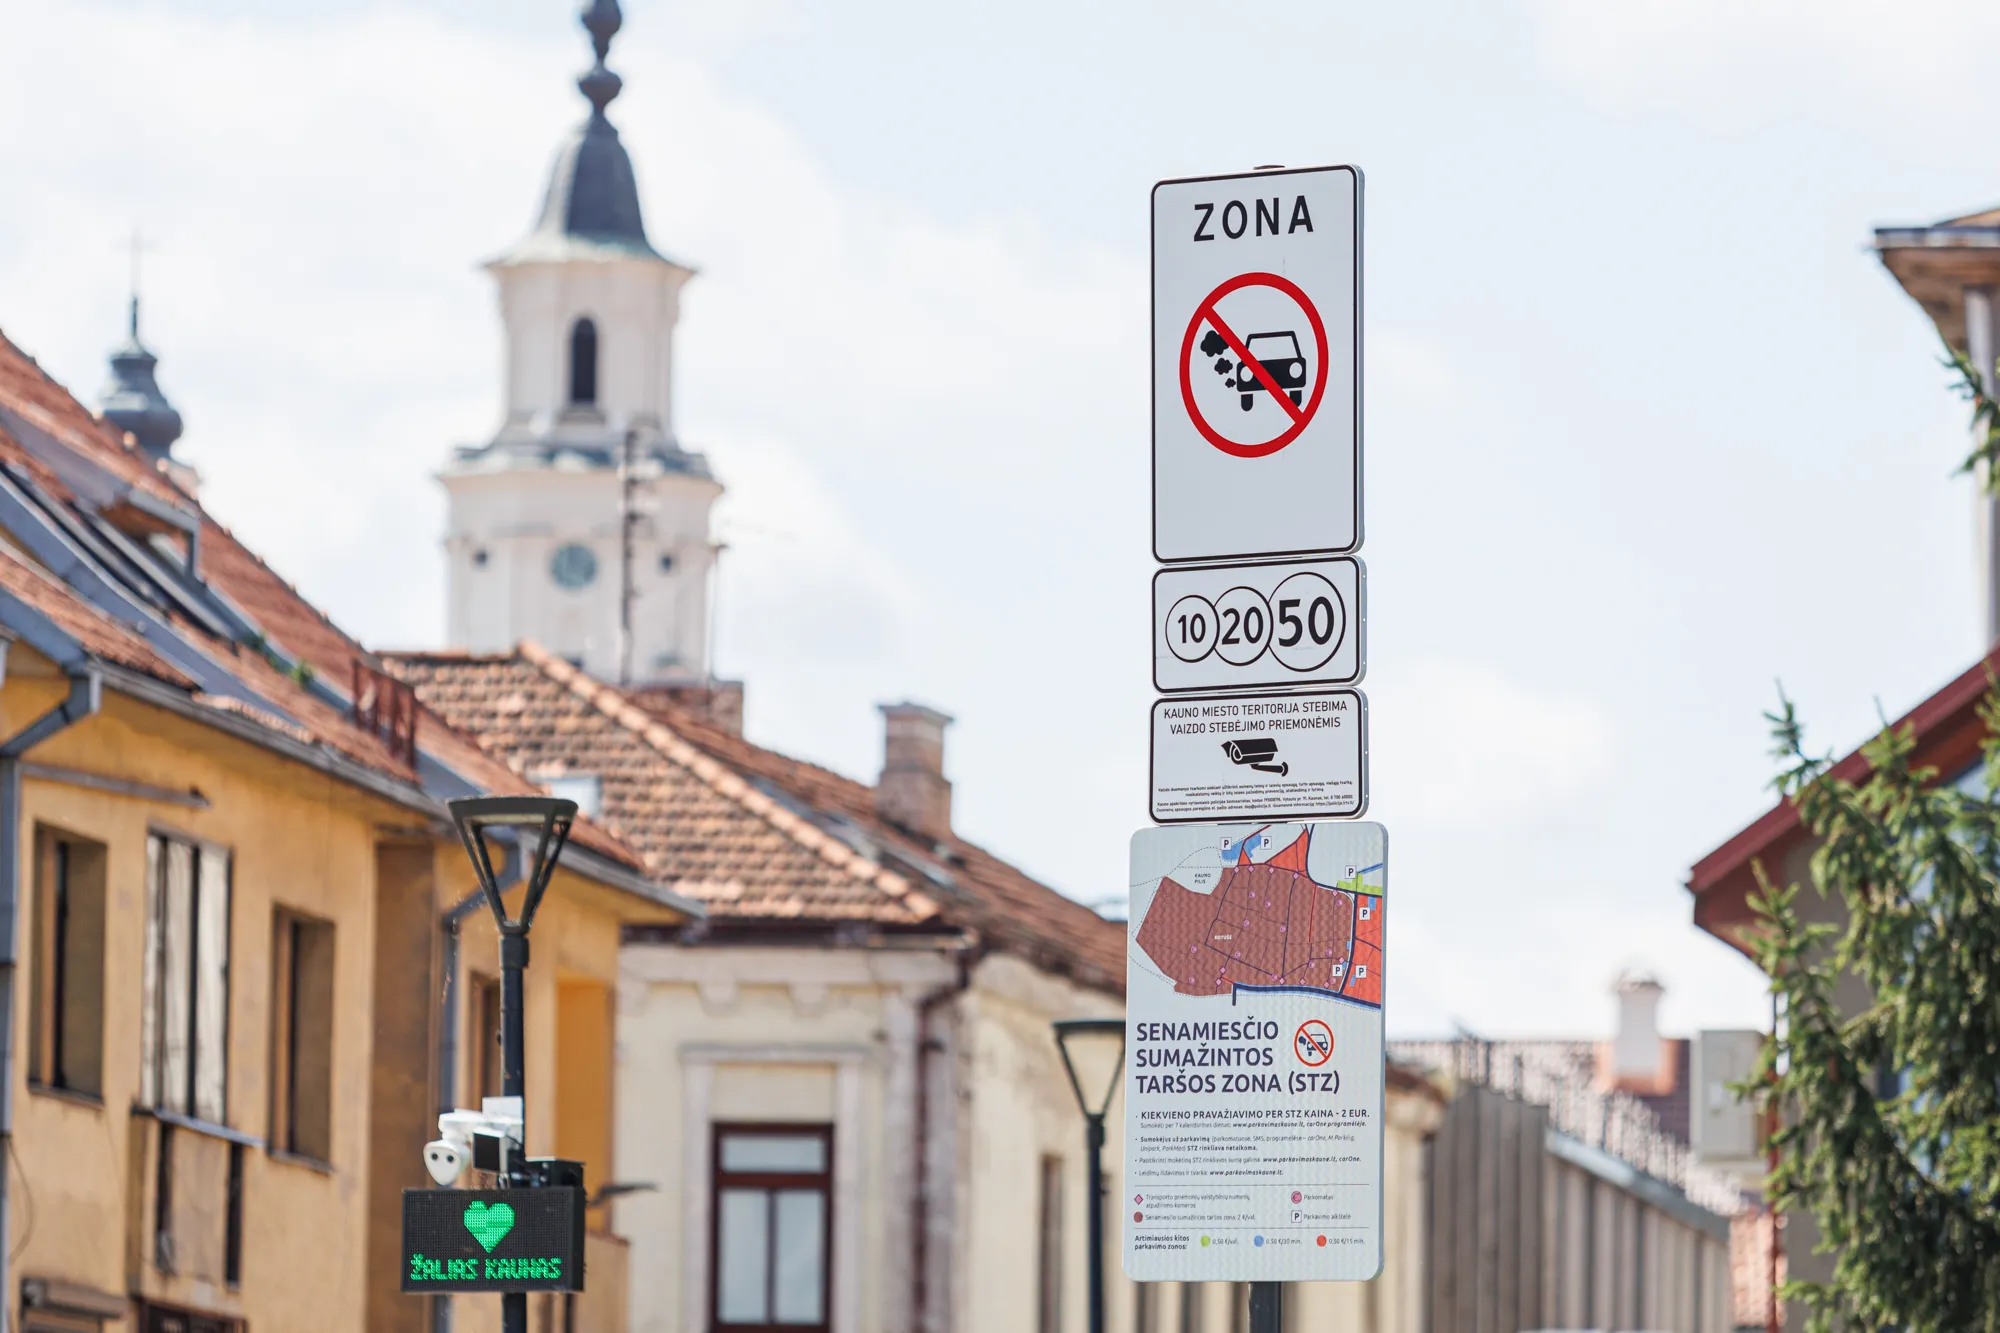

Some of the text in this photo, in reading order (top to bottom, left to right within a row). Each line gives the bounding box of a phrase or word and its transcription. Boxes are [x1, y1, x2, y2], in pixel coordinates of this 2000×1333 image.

[1194, 195, 1314, 242] ZONA
[1178, 596, 1334, 647] 10 20 50
[1164, 700, 1348, 719] KAUNO MIESTO TERITORIJA STEBIMA
[1170, 717, 1340, 734] VAIZDO STEBĖJIMO PRIEMONĖMIS
[1136, 1016, 1279, 1042] SENAMIESČIO
[1136, 1042, 1274, 1067] SUMAŽINTOS
[1136, 1068, 1340, 1094] TARŠOS ZONA (STZ)
[1141, 1111, 1191, 1119] KIEKVIENO
[1193, 1109, 1263, 1119] PRAVAŽIAVIMO
[1266, 1110, 1283, 1119] PER
[1285, 1110, 1302, 1118] STZ
[1304, 1109, 1334, 1118] KAINA
[1342, 1109, 1346, 1117] 2
[1349, 1109, 1370, 1118] EUR.
[410, 1254, 562, 1281] ŽALIAS KAUNAS
